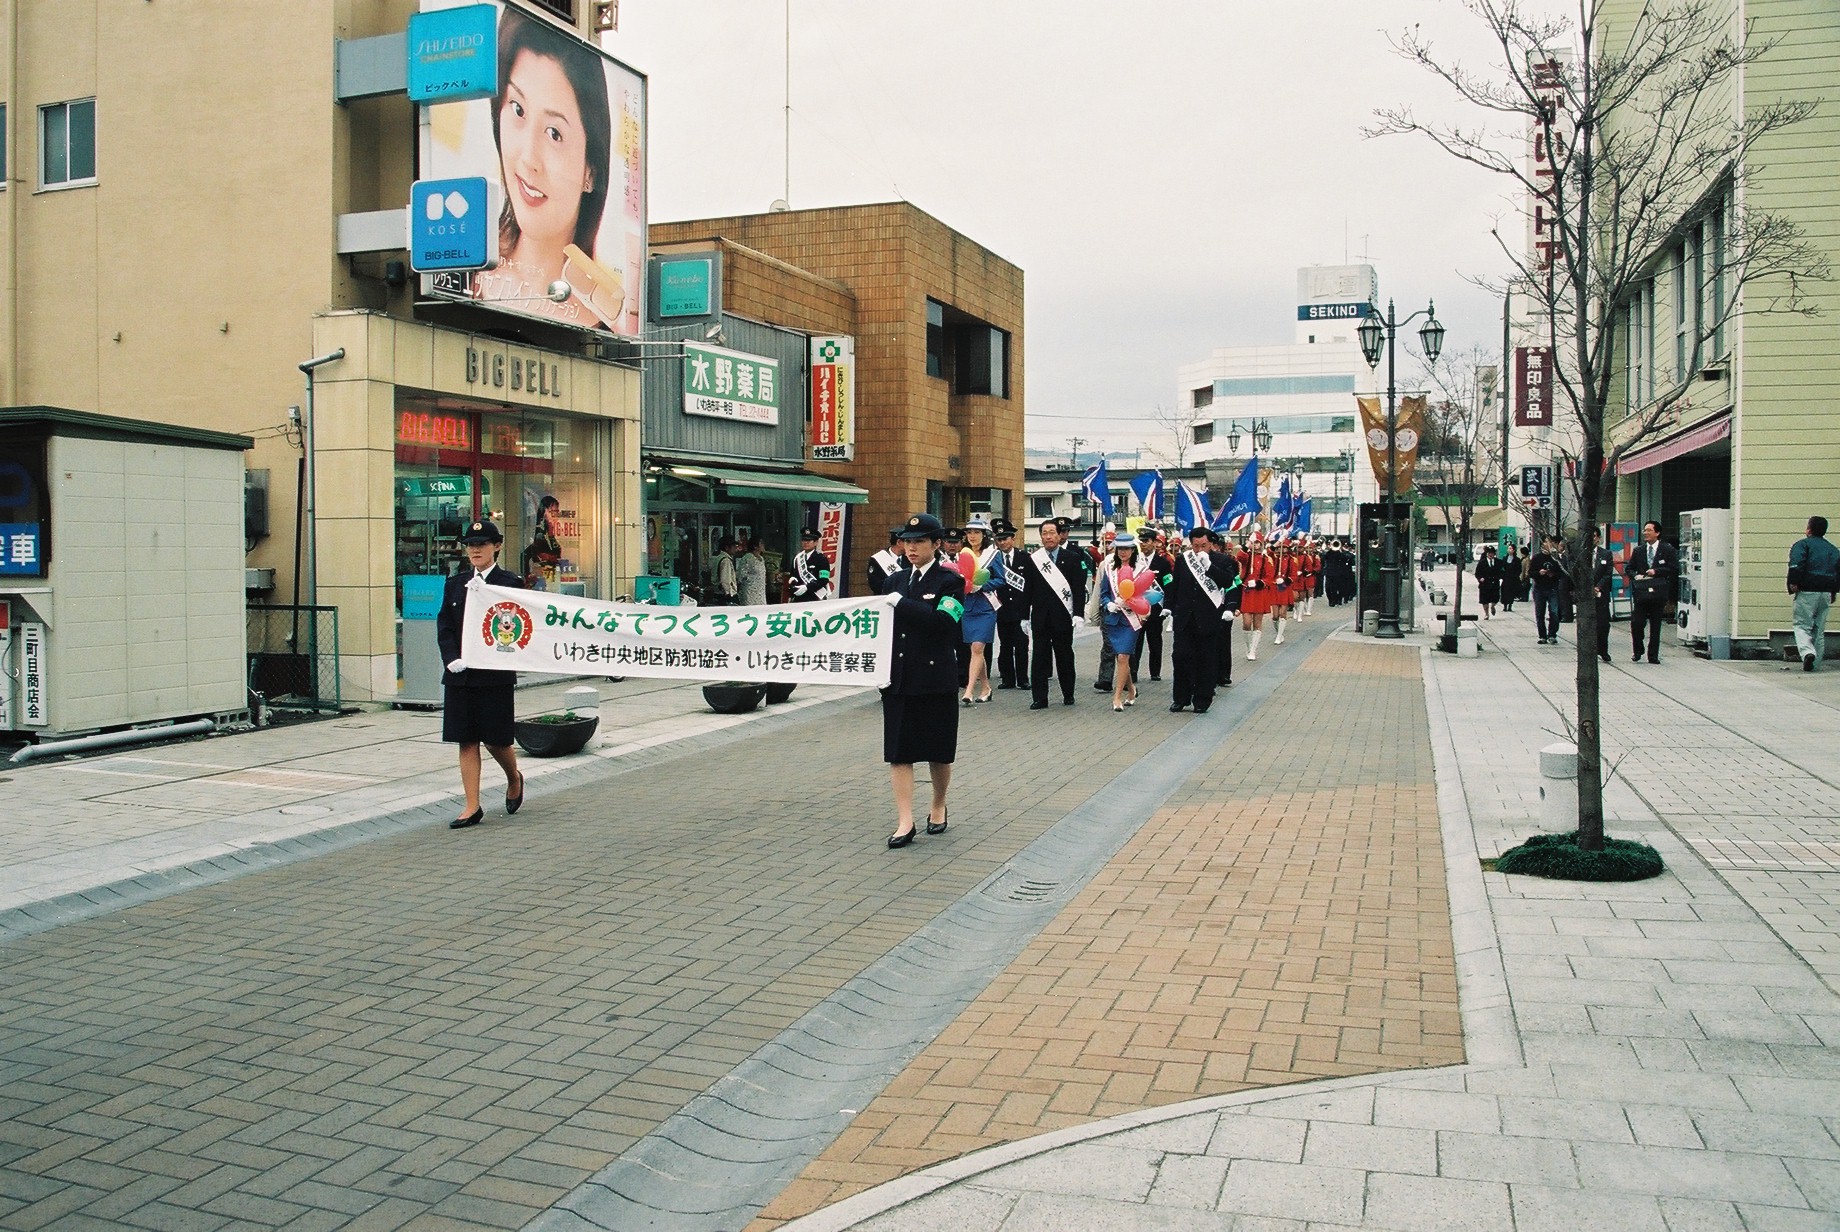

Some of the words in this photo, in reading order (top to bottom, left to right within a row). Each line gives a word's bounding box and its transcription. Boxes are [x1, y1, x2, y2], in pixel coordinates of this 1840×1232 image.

[413, 33, 484, 56] SHISEIDO
[428, 222, 466, 236] KOSÉ
[1309, 305, 1358, 318] SEKINO
[691, 353, 774, 403] 水野薬局
[1526, 355, 1543, 419] 無印良品
[819, 367, 830, 443] ハイチオールC
[0, 533, 36, 566] 車
[545, 604, 880, 639] みんなでつくろう安心の街
[26, 628, 39, 718] 三町目商店会
[553, 642, 877, 673] いわき中央地区防犯協会・いわき中央警察署
